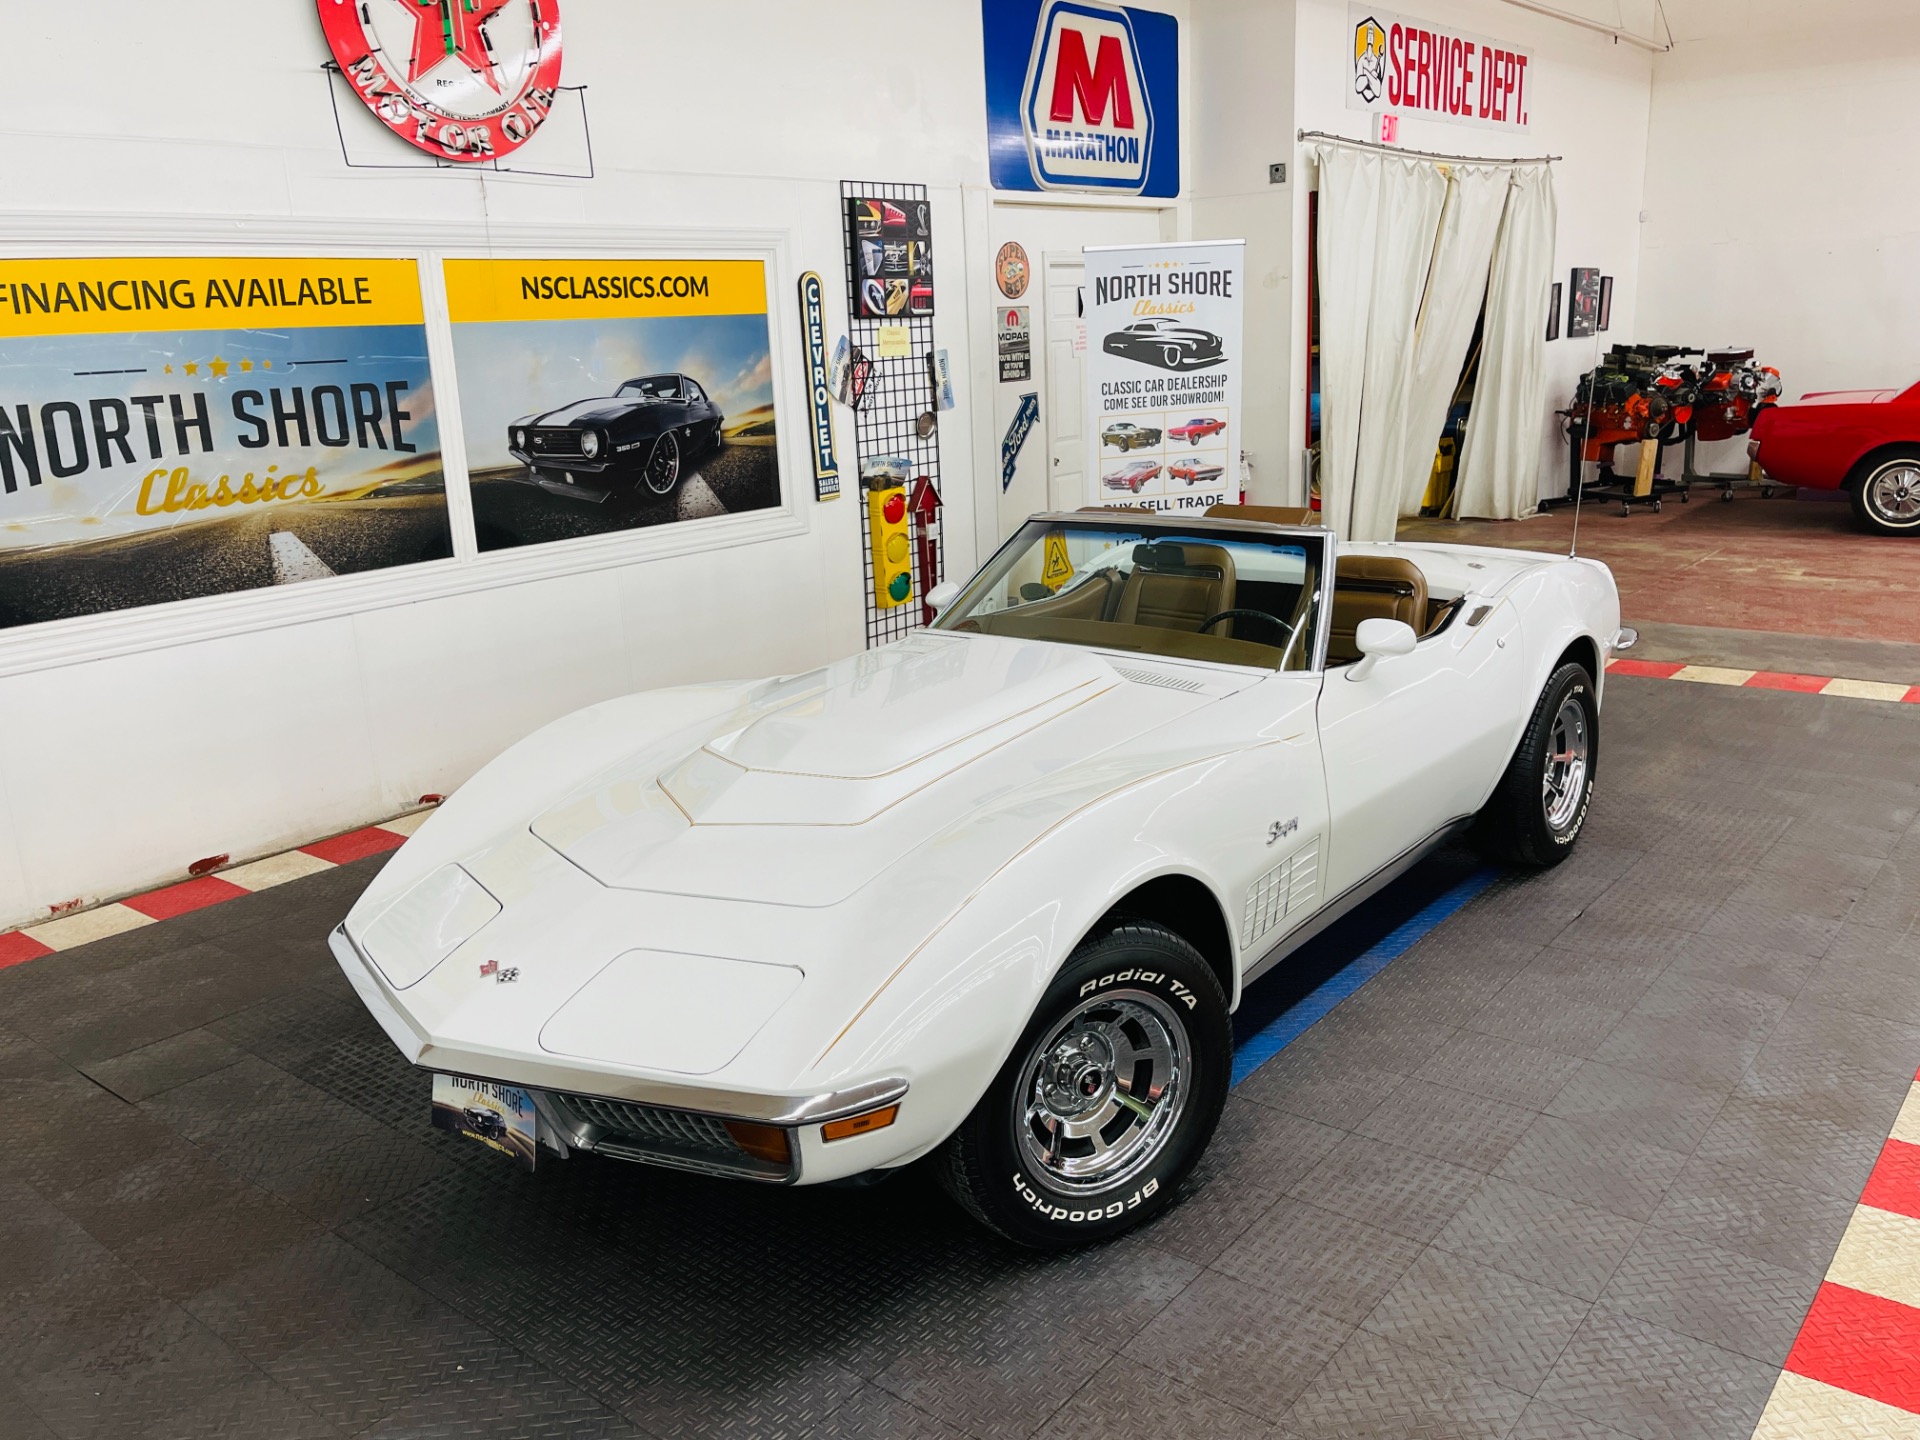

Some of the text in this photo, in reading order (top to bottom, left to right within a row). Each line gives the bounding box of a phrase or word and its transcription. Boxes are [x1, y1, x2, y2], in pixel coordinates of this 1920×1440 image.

[1049, 27, 1135, 130] M
[1388, 22, 1528, 126] SERVICE DEPT.
[347, 54, 557, 158] MOTOR OIL
[1045, 129, 1139, 164] MARATHON
[205, 276, 372, 309] AVAILABLE
[521, 275, 709, 300] NSCLASSICS.COM
[1003, 275, 1025, 296] BEE
[1096, 269, 1232, 306] NORTH SHORE
[1132, 299, 1195, 316] Classics
[998, 331, 1029, 342] MOPAR
[806, 283, 832, 468] CHEVROLET
[1101, 374, 1228, 396] CLASSIC CAR DEALERSHIP
[1104, 390, 1225, 411] COME SEE OUR SHOWROOM!
[0, 380, 417, 494] NORTH SHORE
[136, 464, 326, 516] Classics
[1554, 780, 1594, 845] BFGoodrich
[1079, 968, 1198, 1011] Radial T/A
[451, 1077, 523, 1118] NORTH SHORE
[1012, 1172, 1160, 1223] BFGoodrich
